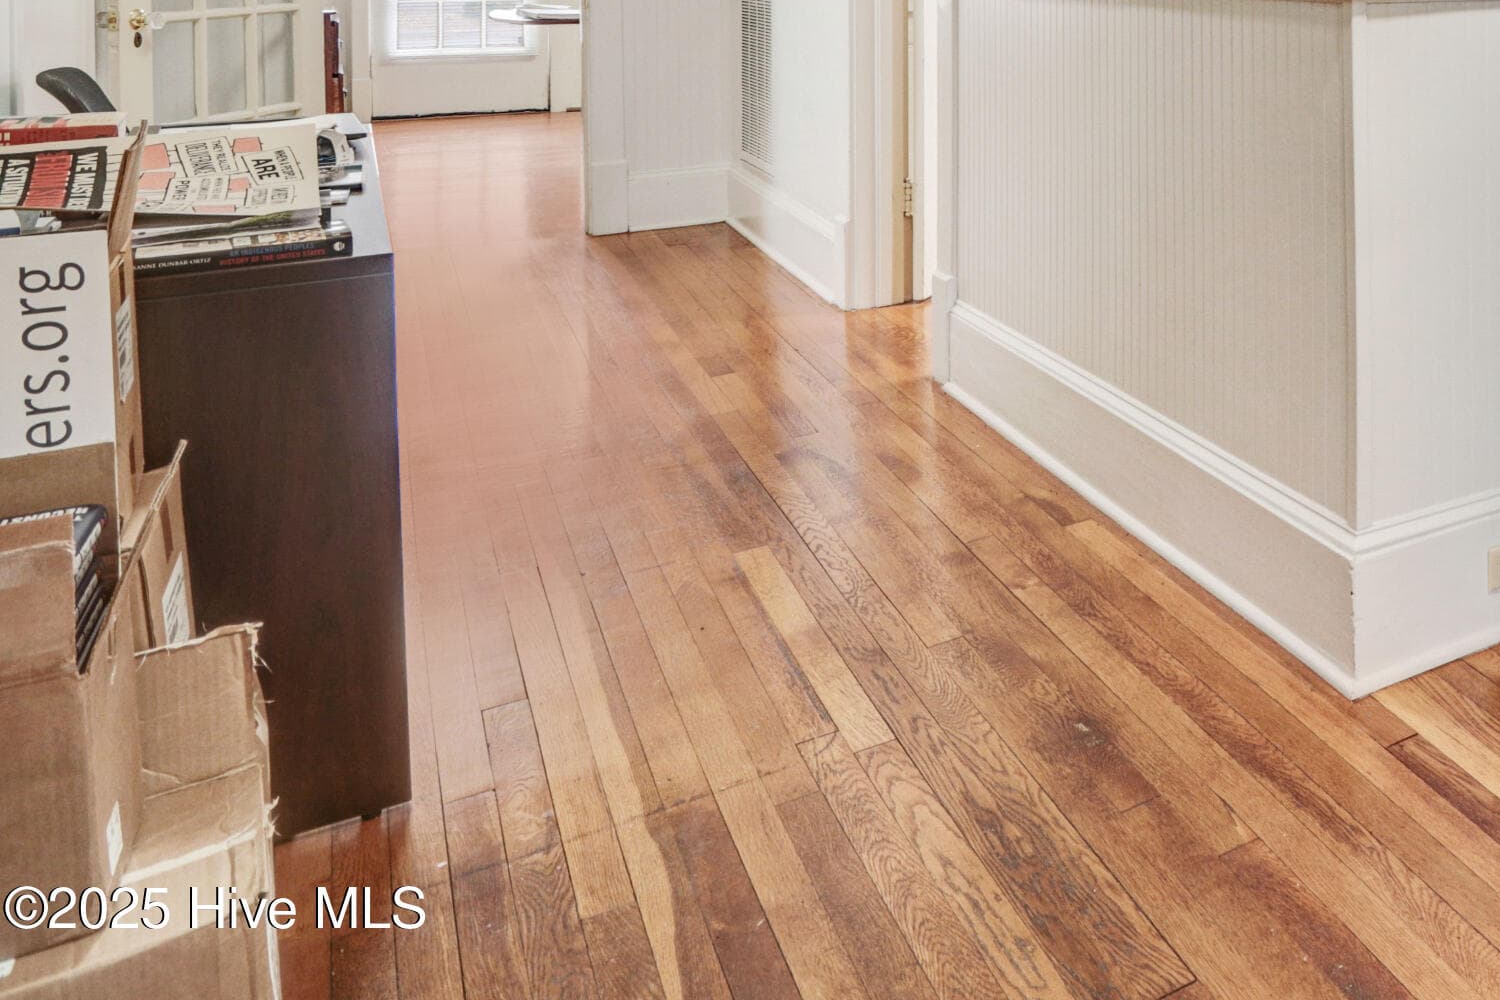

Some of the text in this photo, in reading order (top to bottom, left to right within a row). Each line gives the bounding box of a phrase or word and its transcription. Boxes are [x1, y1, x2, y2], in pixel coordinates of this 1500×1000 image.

[76, 151, 99, 173] WE
[251, 156, 279, 181] ARE
[69, 173, 97, 198] MUST
[19, 261, 86, 448] ers.org
